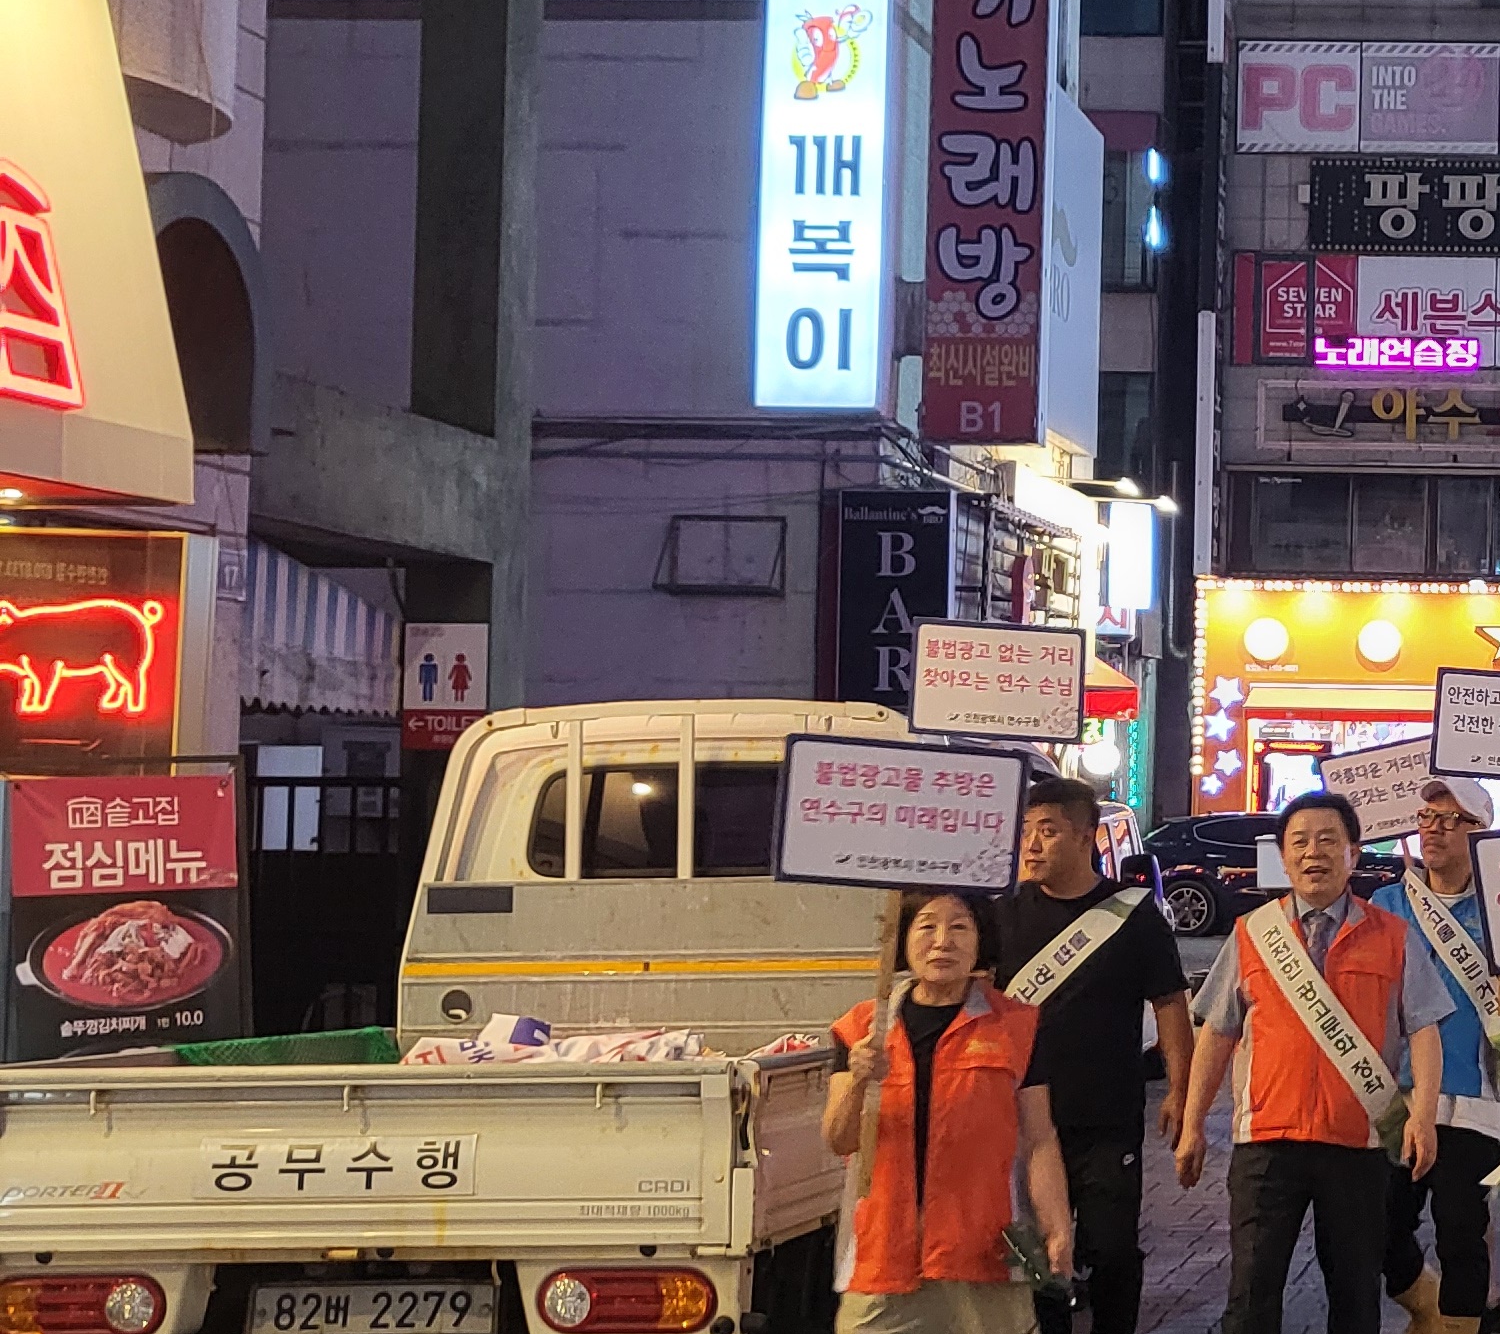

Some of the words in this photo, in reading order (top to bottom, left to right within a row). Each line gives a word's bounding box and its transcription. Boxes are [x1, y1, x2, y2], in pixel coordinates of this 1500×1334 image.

[1371, 66, 1417, 86] INTO
[1241, 63, 1357, 132] PC
[1372, 89, 1407, 110] THE
[785, 133, 862, 372] 깨복이
[959, 402, 1003, 434] B1
[1371, 387, 1481, 441] 야수
[844, 506, 918, 520] Ballantine's
[925, 637, 992, 659] 불법광고
[998, 643, 1034, 665] 없는
[1040, 644, 1075, 666] 거리
[923, 667, 992, 691] 찾아오는
[997, 673, 1031, 693] 연수
[1036, 676, 1074, 697] 손님
[1452, 712, 1496, 735] 건전한
[1385, 750, 1430, 775] 거리미
[815, 759, 925, 792] 불법광고물
[932, 770, 997, 798] 추방은
[1349, 784, 1389, 808] 음짓는
[42, 838, 207, 890] 점심메뉴
[175, 1010, 204, 1027] 10.0
[1294, 978, 1358, 1059] 광고문화
[211, 1140, 463, 1192] 공무수행
[647, 1205, 690, 1218] 1000kg
[274, 1292, 350, 1332] 82버
[368, 1290, 472, 1331] 2279
